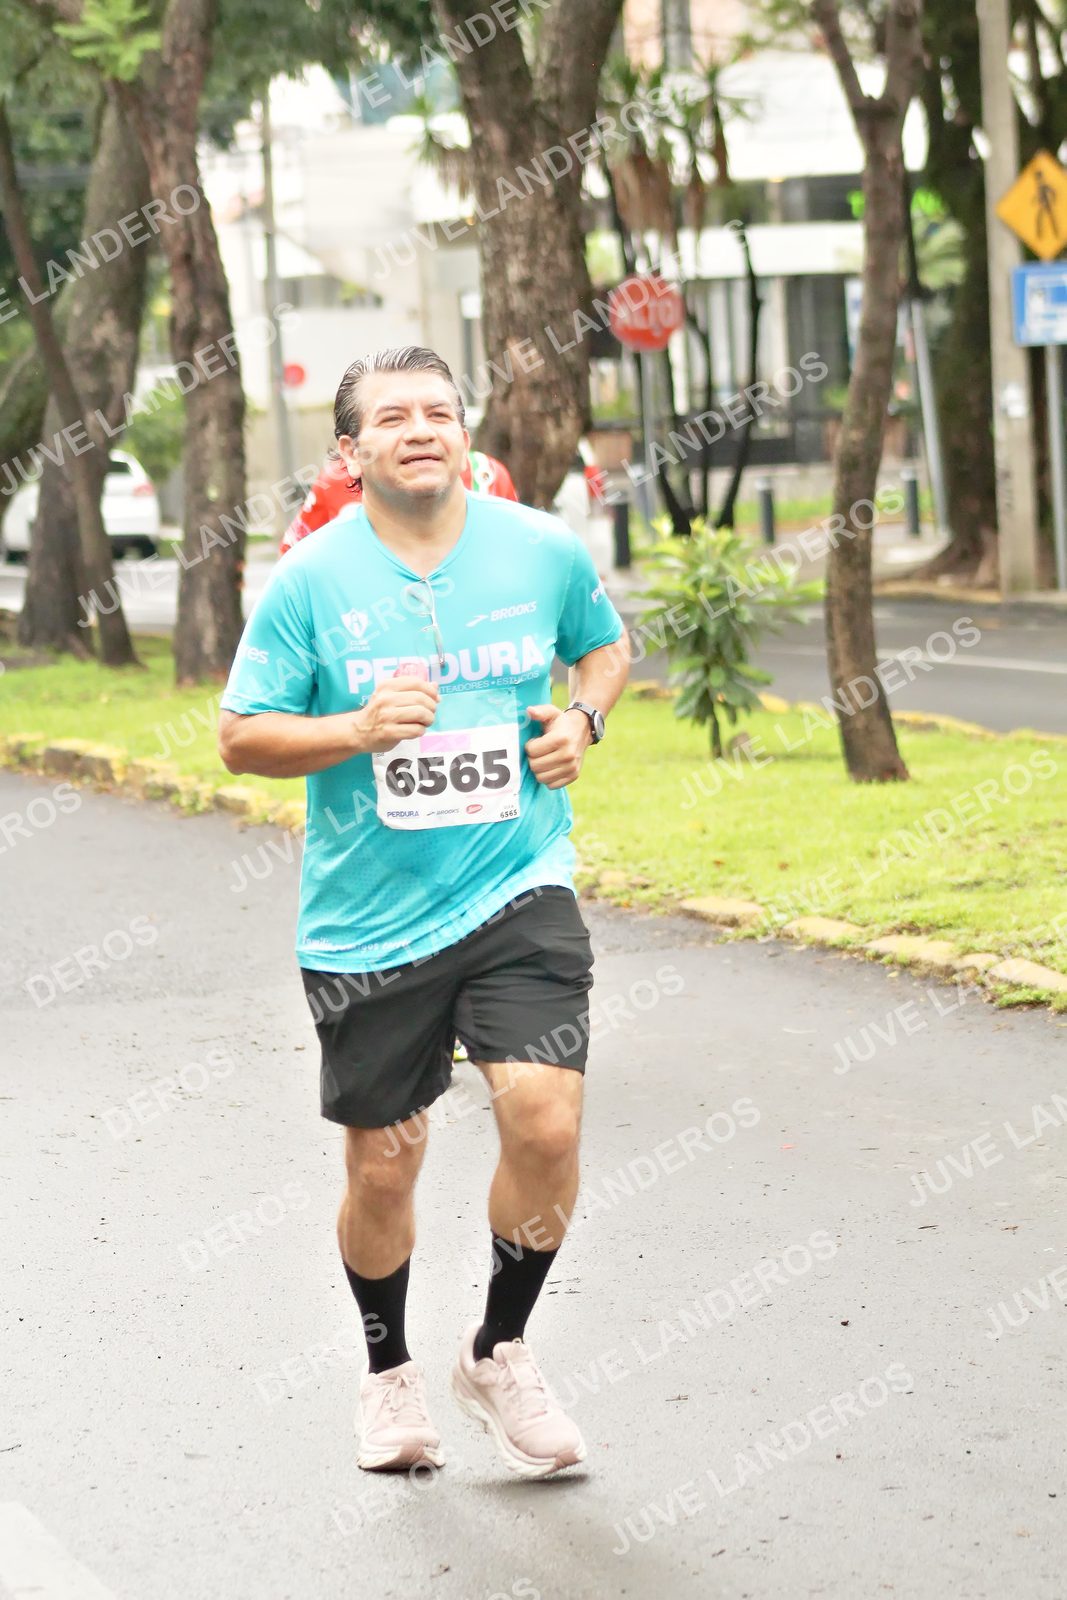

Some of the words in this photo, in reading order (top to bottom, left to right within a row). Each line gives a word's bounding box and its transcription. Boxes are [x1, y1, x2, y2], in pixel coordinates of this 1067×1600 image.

[490, 601, 537, 621] BROOKS
[386, 749, 511, 797] 6565
[500, 809, 517, 818] 6565
